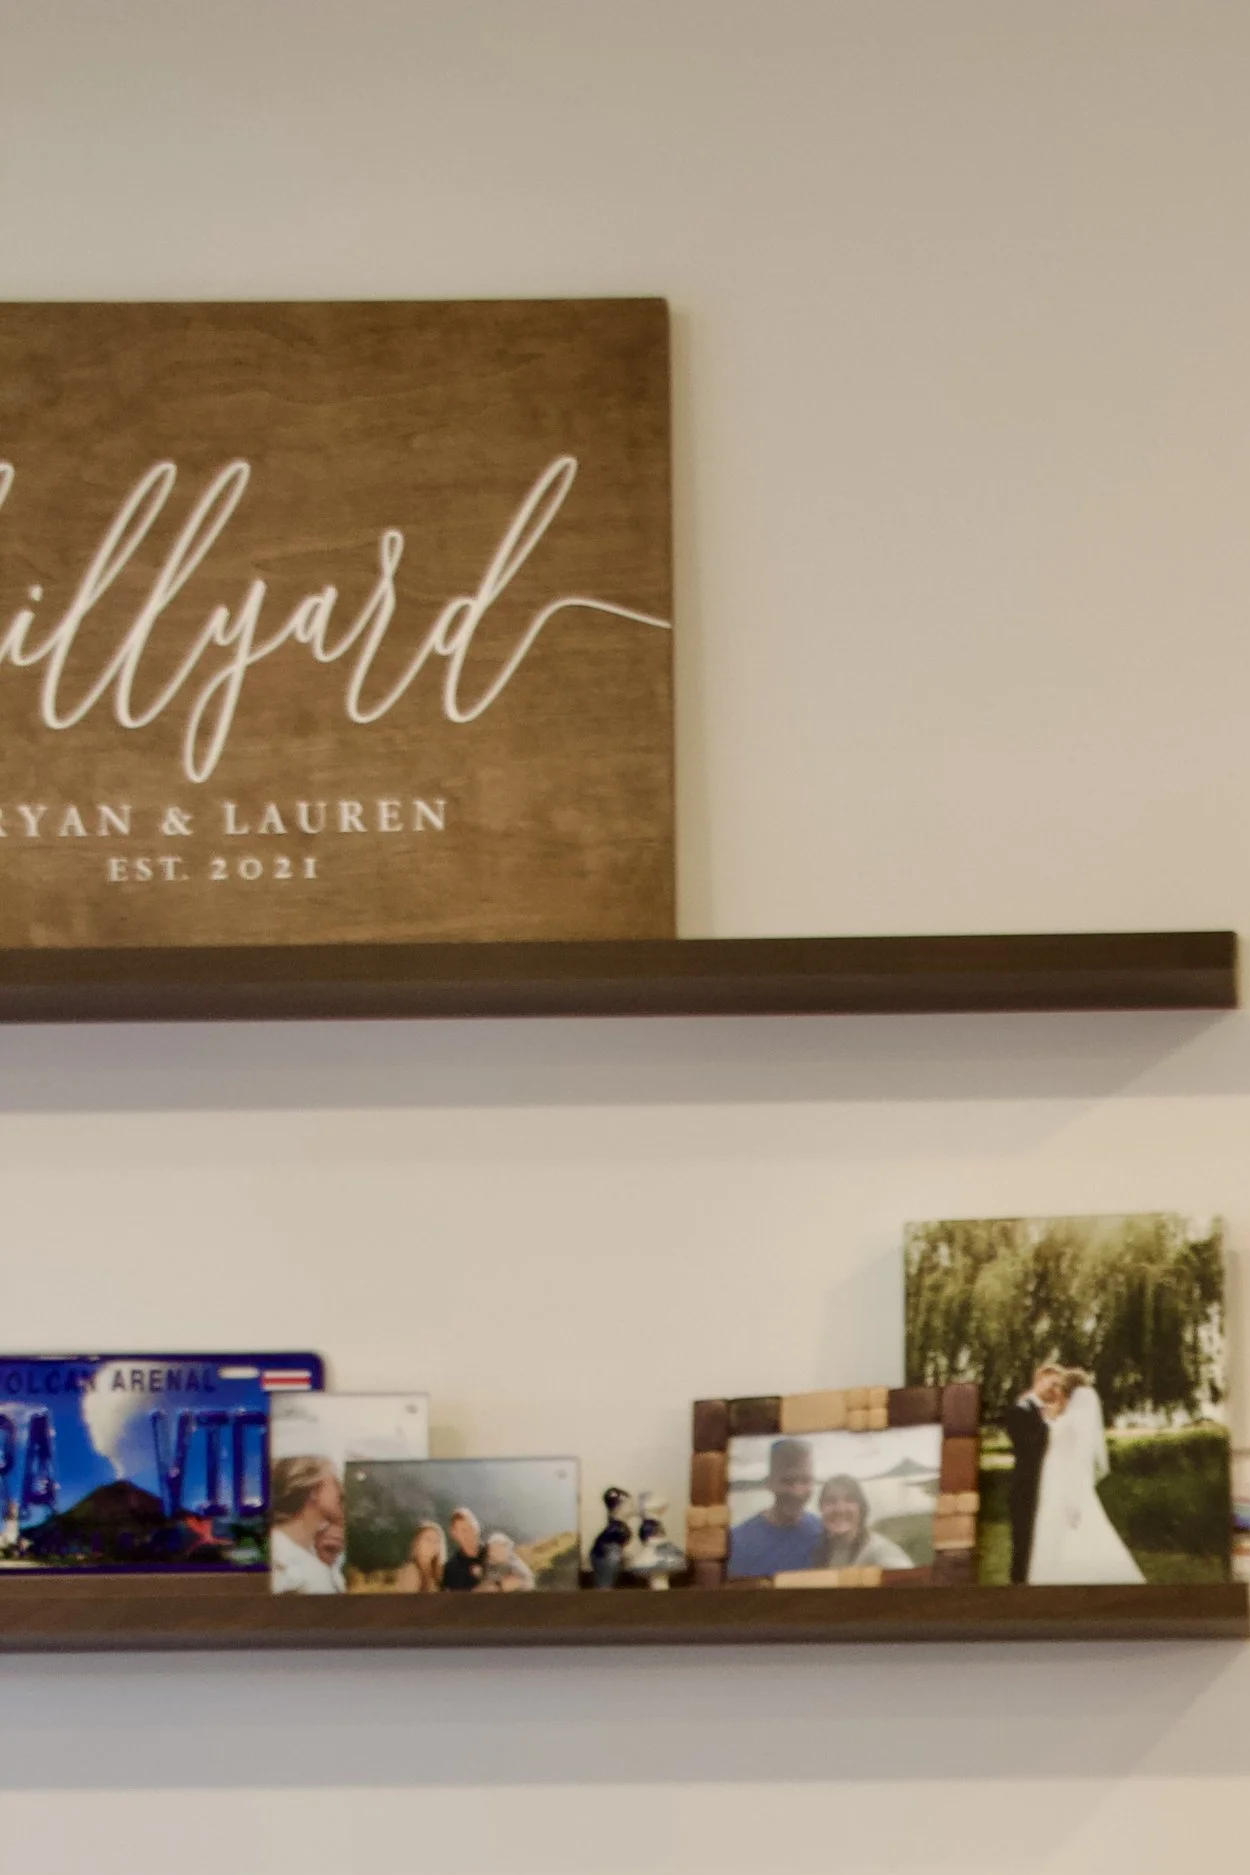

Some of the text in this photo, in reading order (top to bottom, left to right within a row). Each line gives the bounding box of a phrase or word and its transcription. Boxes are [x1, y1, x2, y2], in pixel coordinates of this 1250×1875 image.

[0, 456, 671, 783] illyard
[0, 798, 447, 838] YAN & LAUREN
[107, 855, 317, 882] EST. 2021
[111, 1364, 217, 1393] ARENAL
